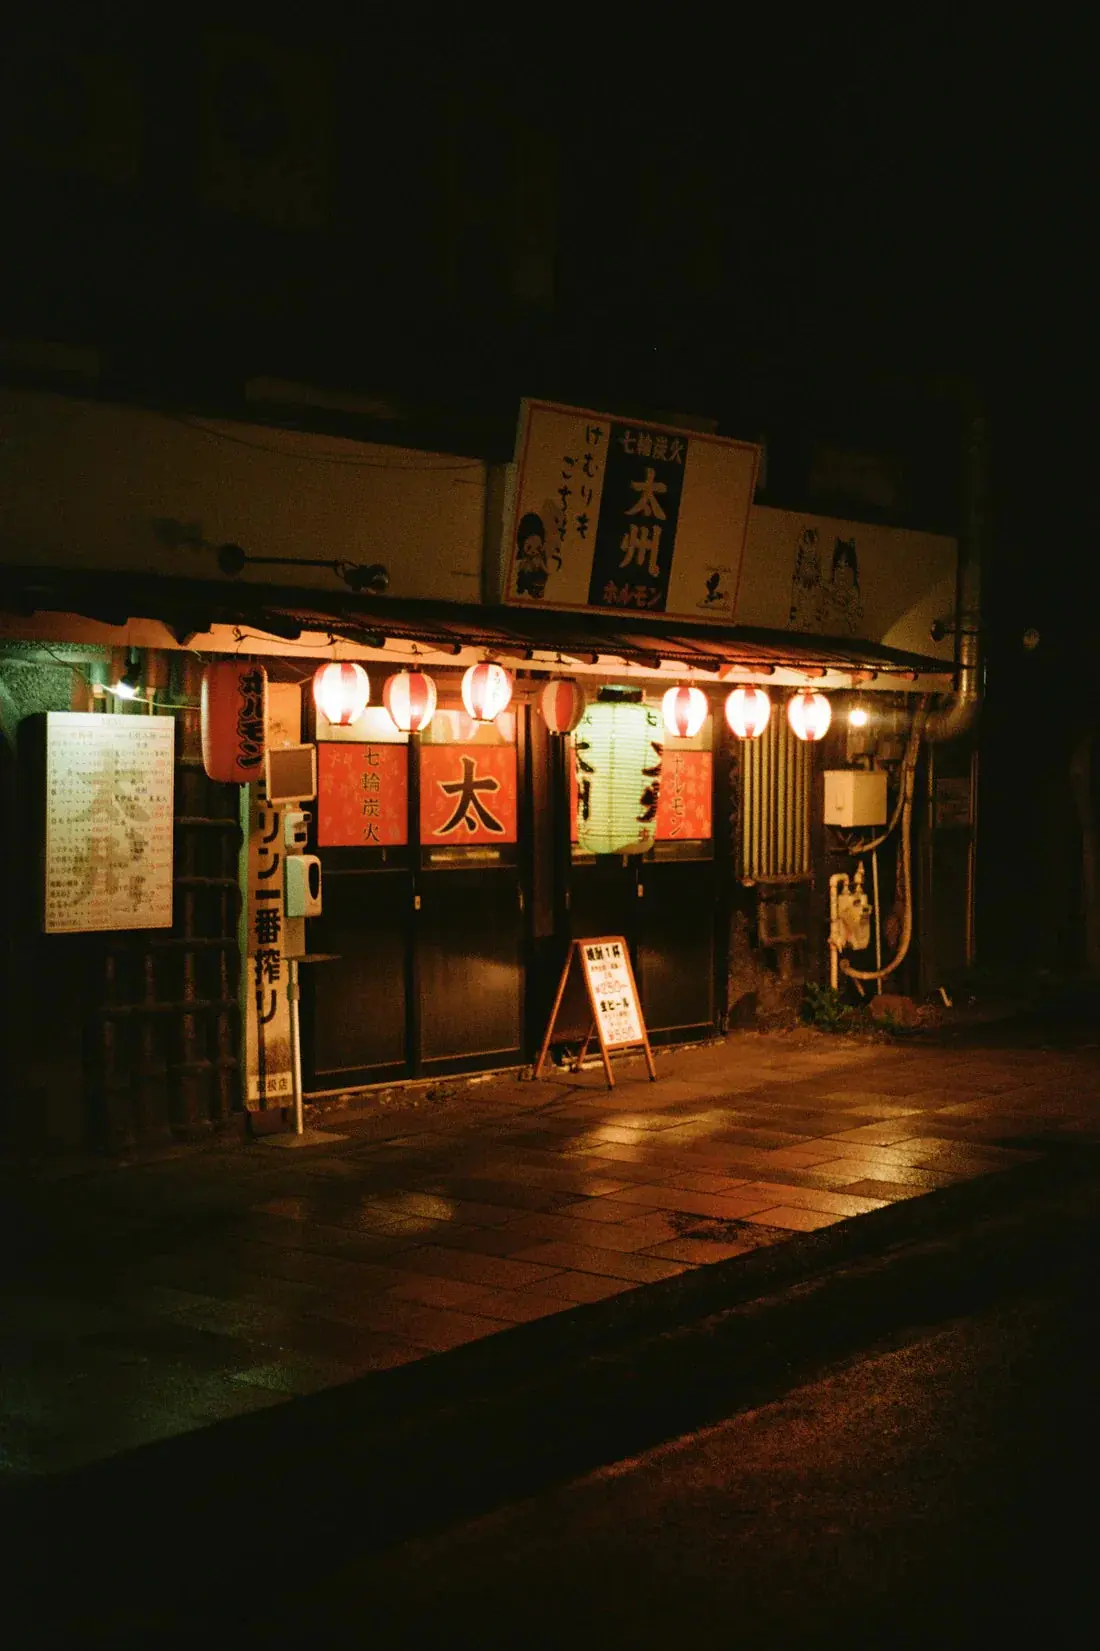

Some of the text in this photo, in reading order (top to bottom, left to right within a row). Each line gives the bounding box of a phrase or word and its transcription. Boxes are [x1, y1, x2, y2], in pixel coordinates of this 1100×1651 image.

[577, 424, 603, 540] けむりも
[619, 431, 685, 464] 七輪炭火
[552, 456, 578, 572] ごちそう
[619, 468, 667, 577] 太州
[602, 580, 661, 607] ホルモン
[361, 747, 381, 842] 七輪炭火
[435, 756, 504, 834] 太
